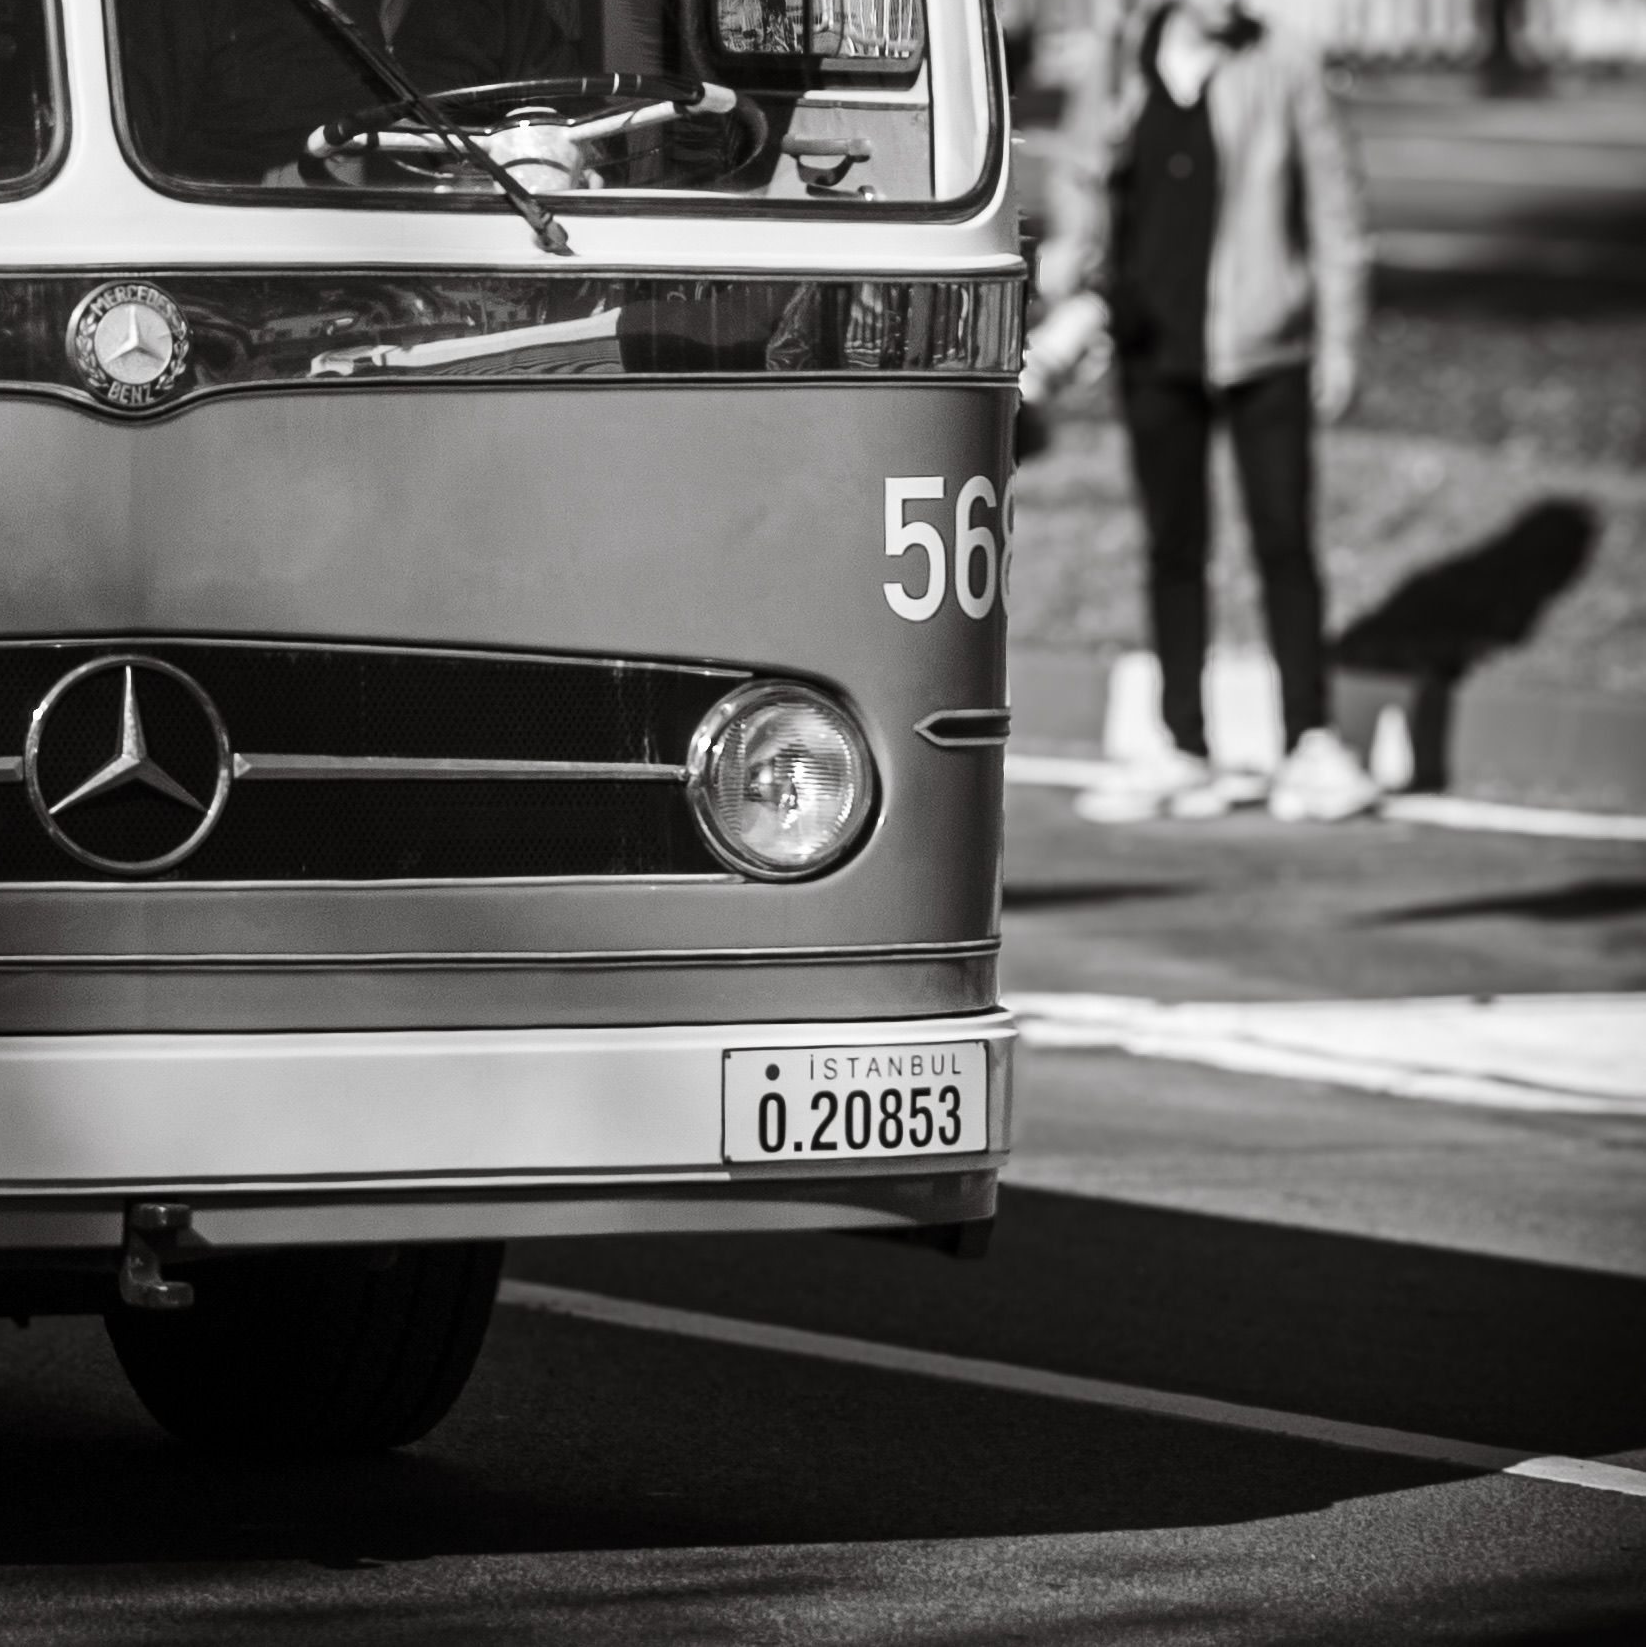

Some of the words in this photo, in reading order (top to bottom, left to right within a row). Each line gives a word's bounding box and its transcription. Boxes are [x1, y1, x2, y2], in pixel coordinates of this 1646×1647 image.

[108, 381, 154, 404] BENZ
[810, 1053, 961, 1080] İSTANBUL
[758, 1085, 961, 1153] 0.20853
